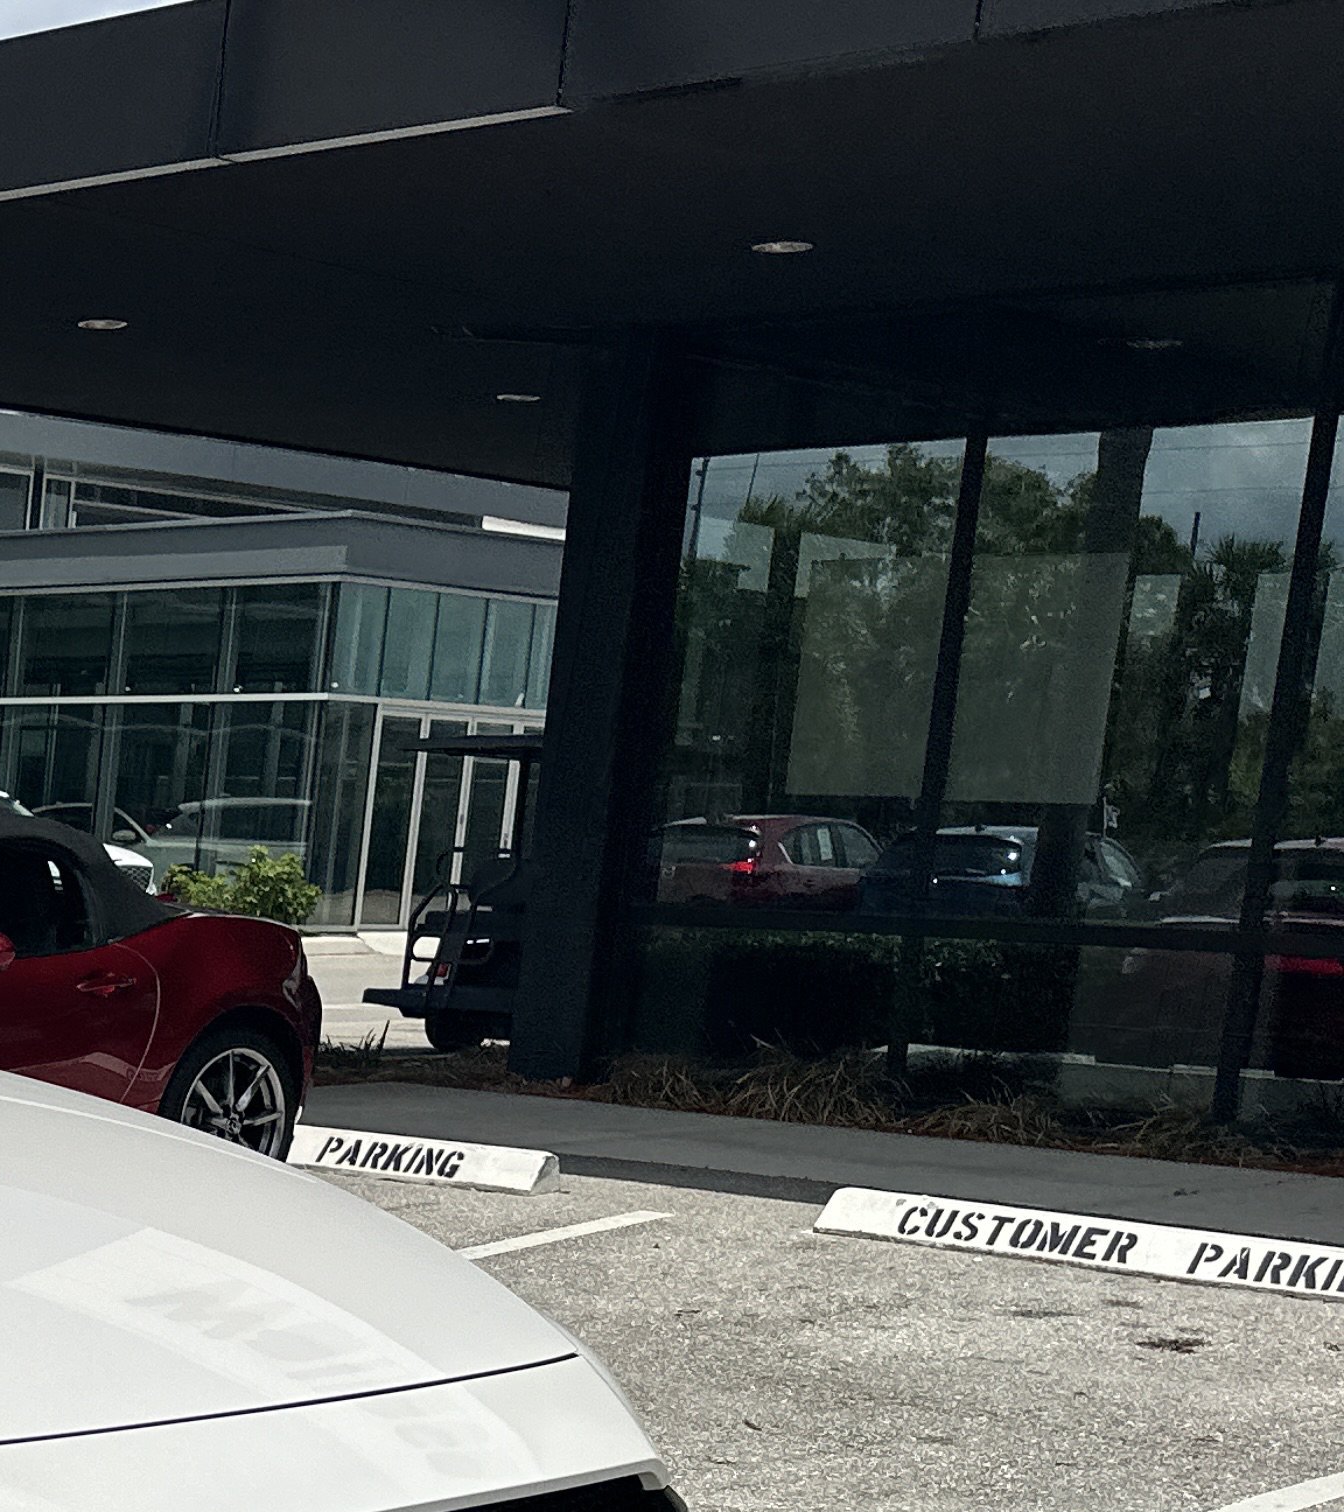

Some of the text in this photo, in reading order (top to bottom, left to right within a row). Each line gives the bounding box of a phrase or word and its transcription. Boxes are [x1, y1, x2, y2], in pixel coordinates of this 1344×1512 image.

[315, 1136, 464, 1178] PARKING
[898, 1206, 1344, 1292] CUSTOMER PARKI
